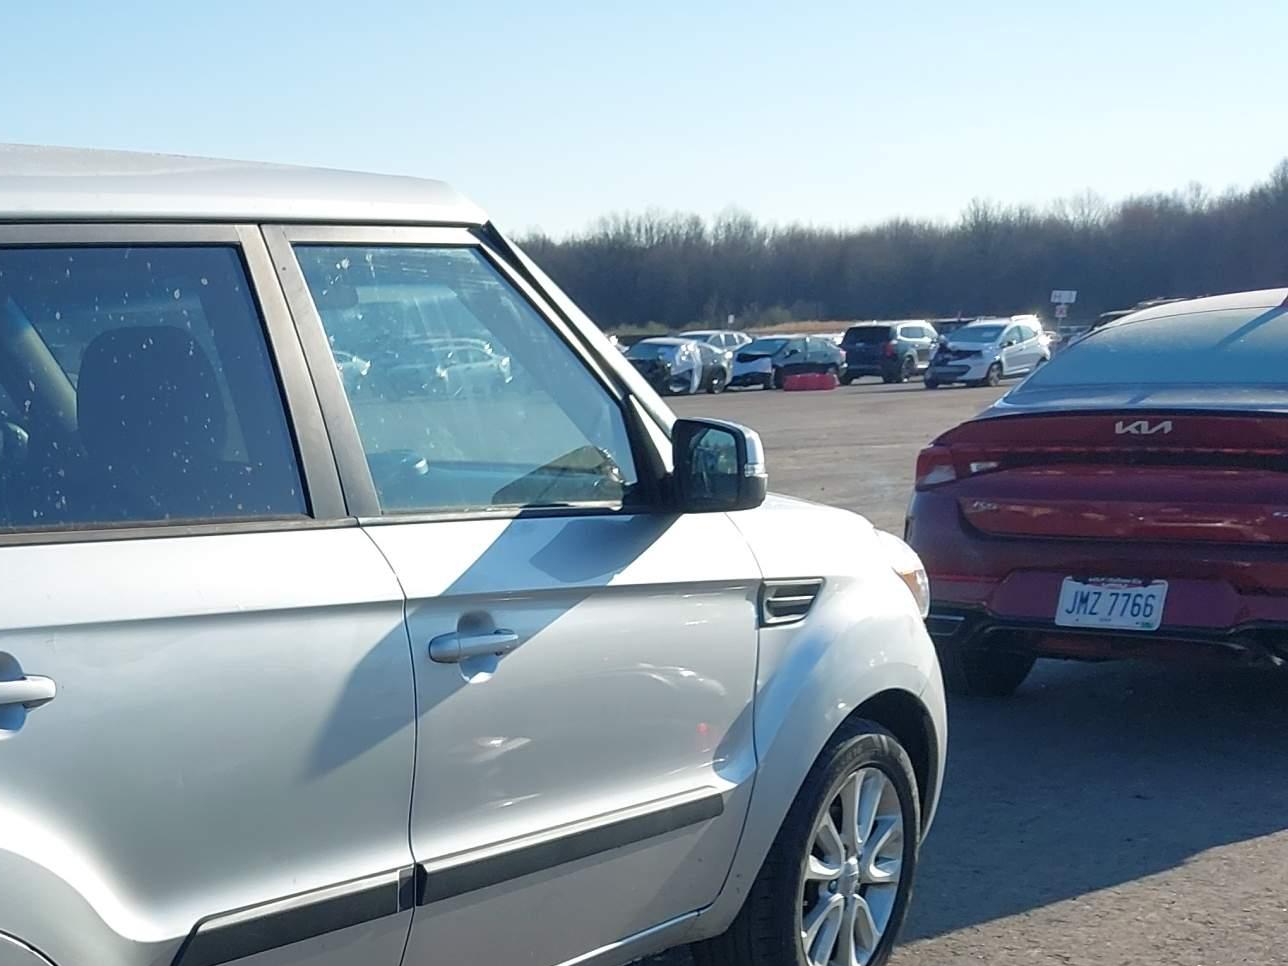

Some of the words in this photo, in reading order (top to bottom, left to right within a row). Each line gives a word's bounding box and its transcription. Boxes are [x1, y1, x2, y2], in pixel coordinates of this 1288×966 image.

[1114, 420, 1173, 435] KIA
[1065, 590, 1102, 616] JMZ
[1108, 592, 1156, 618] 7766
